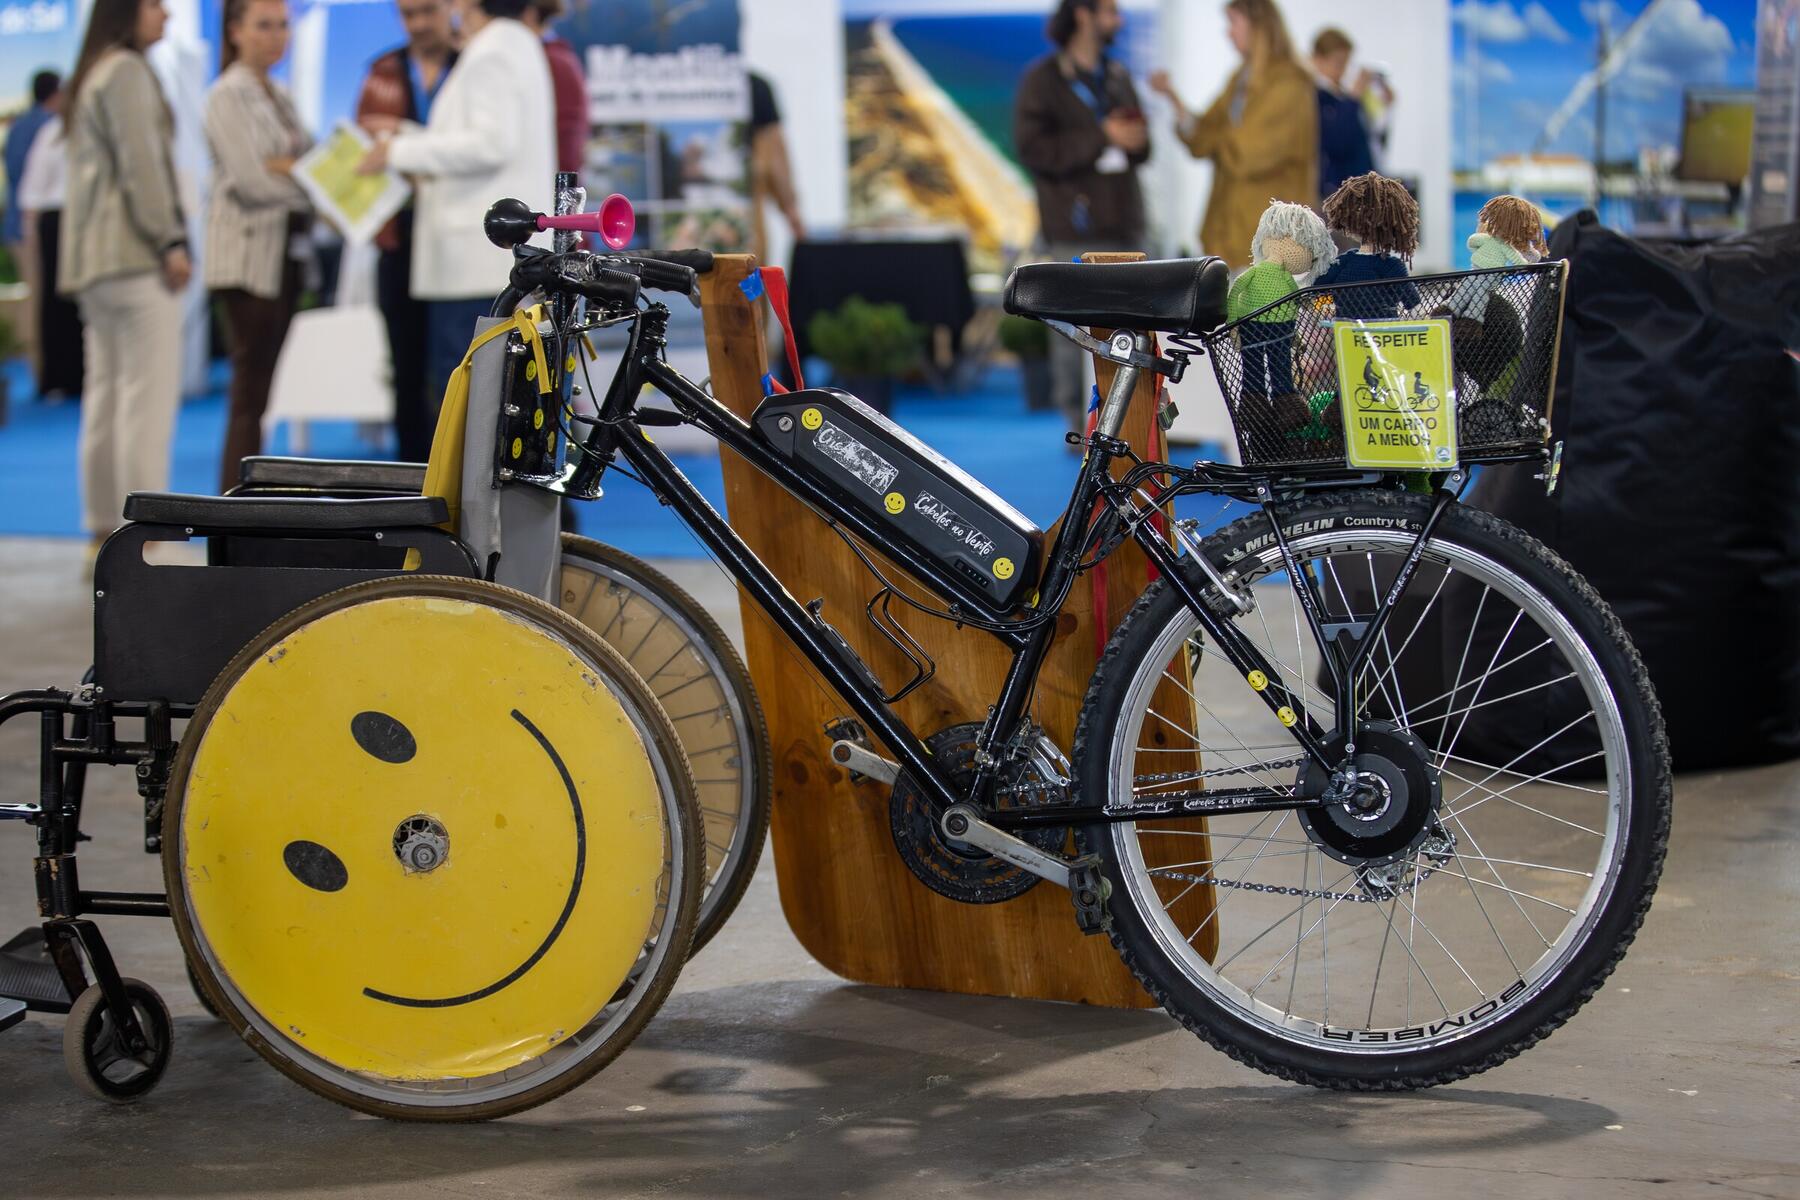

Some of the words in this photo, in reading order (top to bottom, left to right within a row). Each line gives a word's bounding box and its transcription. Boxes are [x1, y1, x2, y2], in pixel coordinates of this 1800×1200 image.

[1354, 333, 1428, 348] RESPEITE
[1360, 417, 1380, 430] UM
[1383, 417, 1437, 431] CARRO
[1367, 433, 1377, 446] A
[1380, 433, 1431, 447] MENOS
[1343, 516, 1395, 528] Country
[1245, 518, 1335, 552] MICHELIN
[1322, 979, 1527, 1042] BOMBER
